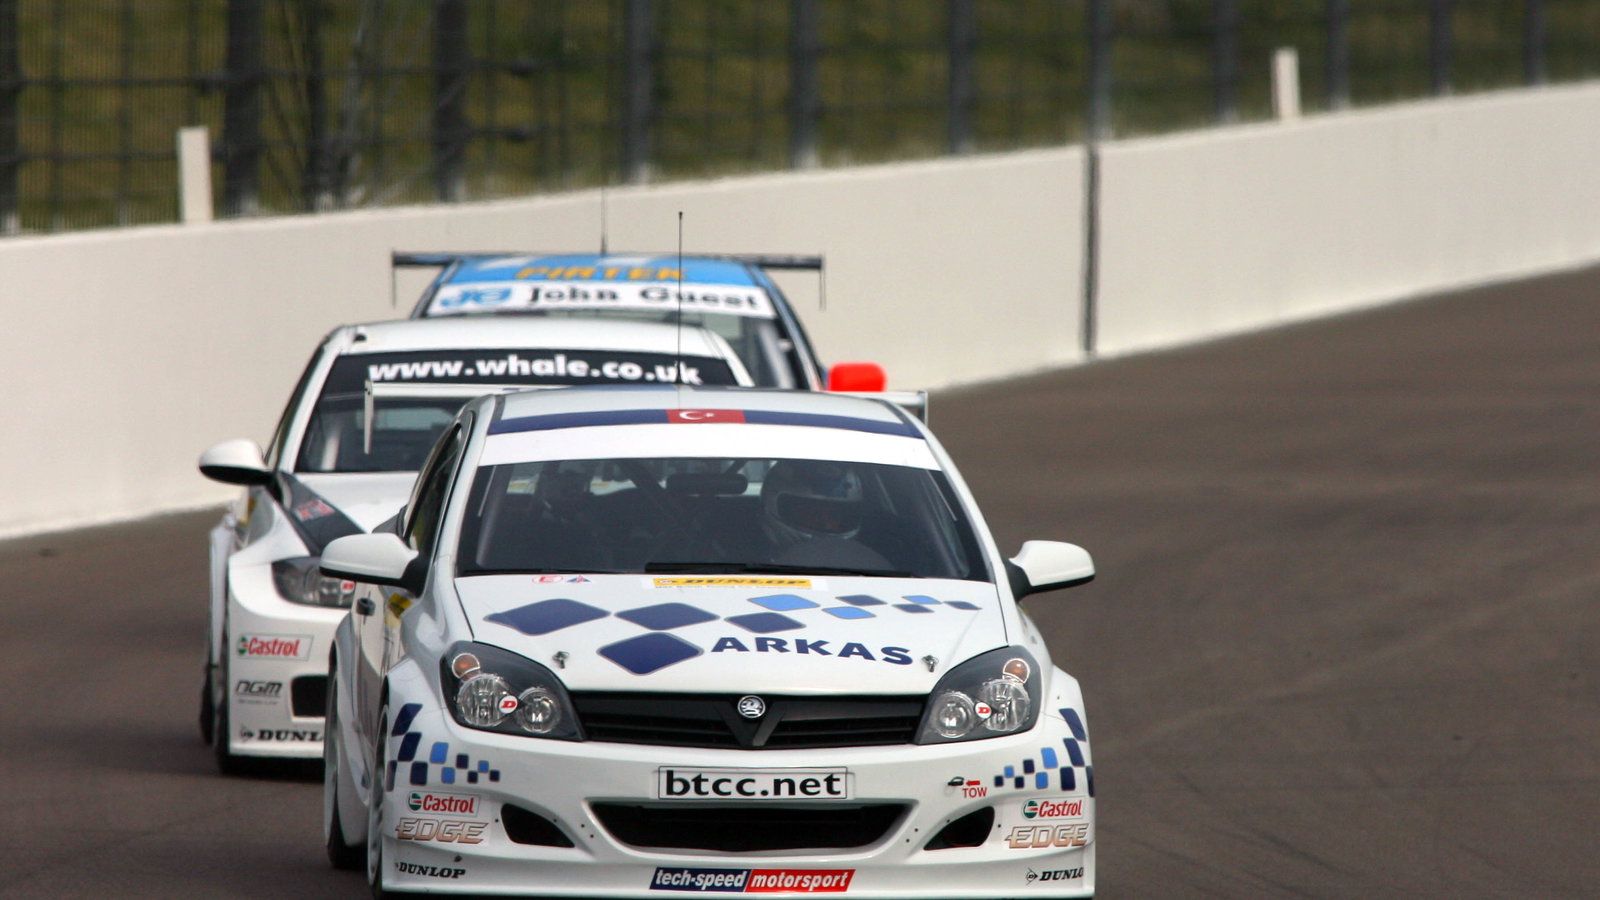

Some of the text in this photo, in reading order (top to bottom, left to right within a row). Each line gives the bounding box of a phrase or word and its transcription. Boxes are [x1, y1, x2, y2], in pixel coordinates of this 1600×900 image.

[529, 286, 757, 307] John Guest
[369, 354, 702, 384] www.whale.co.uk
[247, 637, 300, 657] Castrol
[711, 637, 913, 665] ARKAS
[257, 729, 324, 742] DUNL
[666, 770, 841, 796] btcc.net
[962, 787, 988, 799] TOW
[423, 794, 474, 814] Castrol
[1038, 799, 1082, 817] Castrol
[395, 817, 489, 844] EDGE
[1005, 823, 1090, 849] EDGE
[399, 862, 466, 879] DUNLOP
[655, 868, 849, 892] tech-speed motorsport
[1039, 867, 1084, 881] DUNLO
